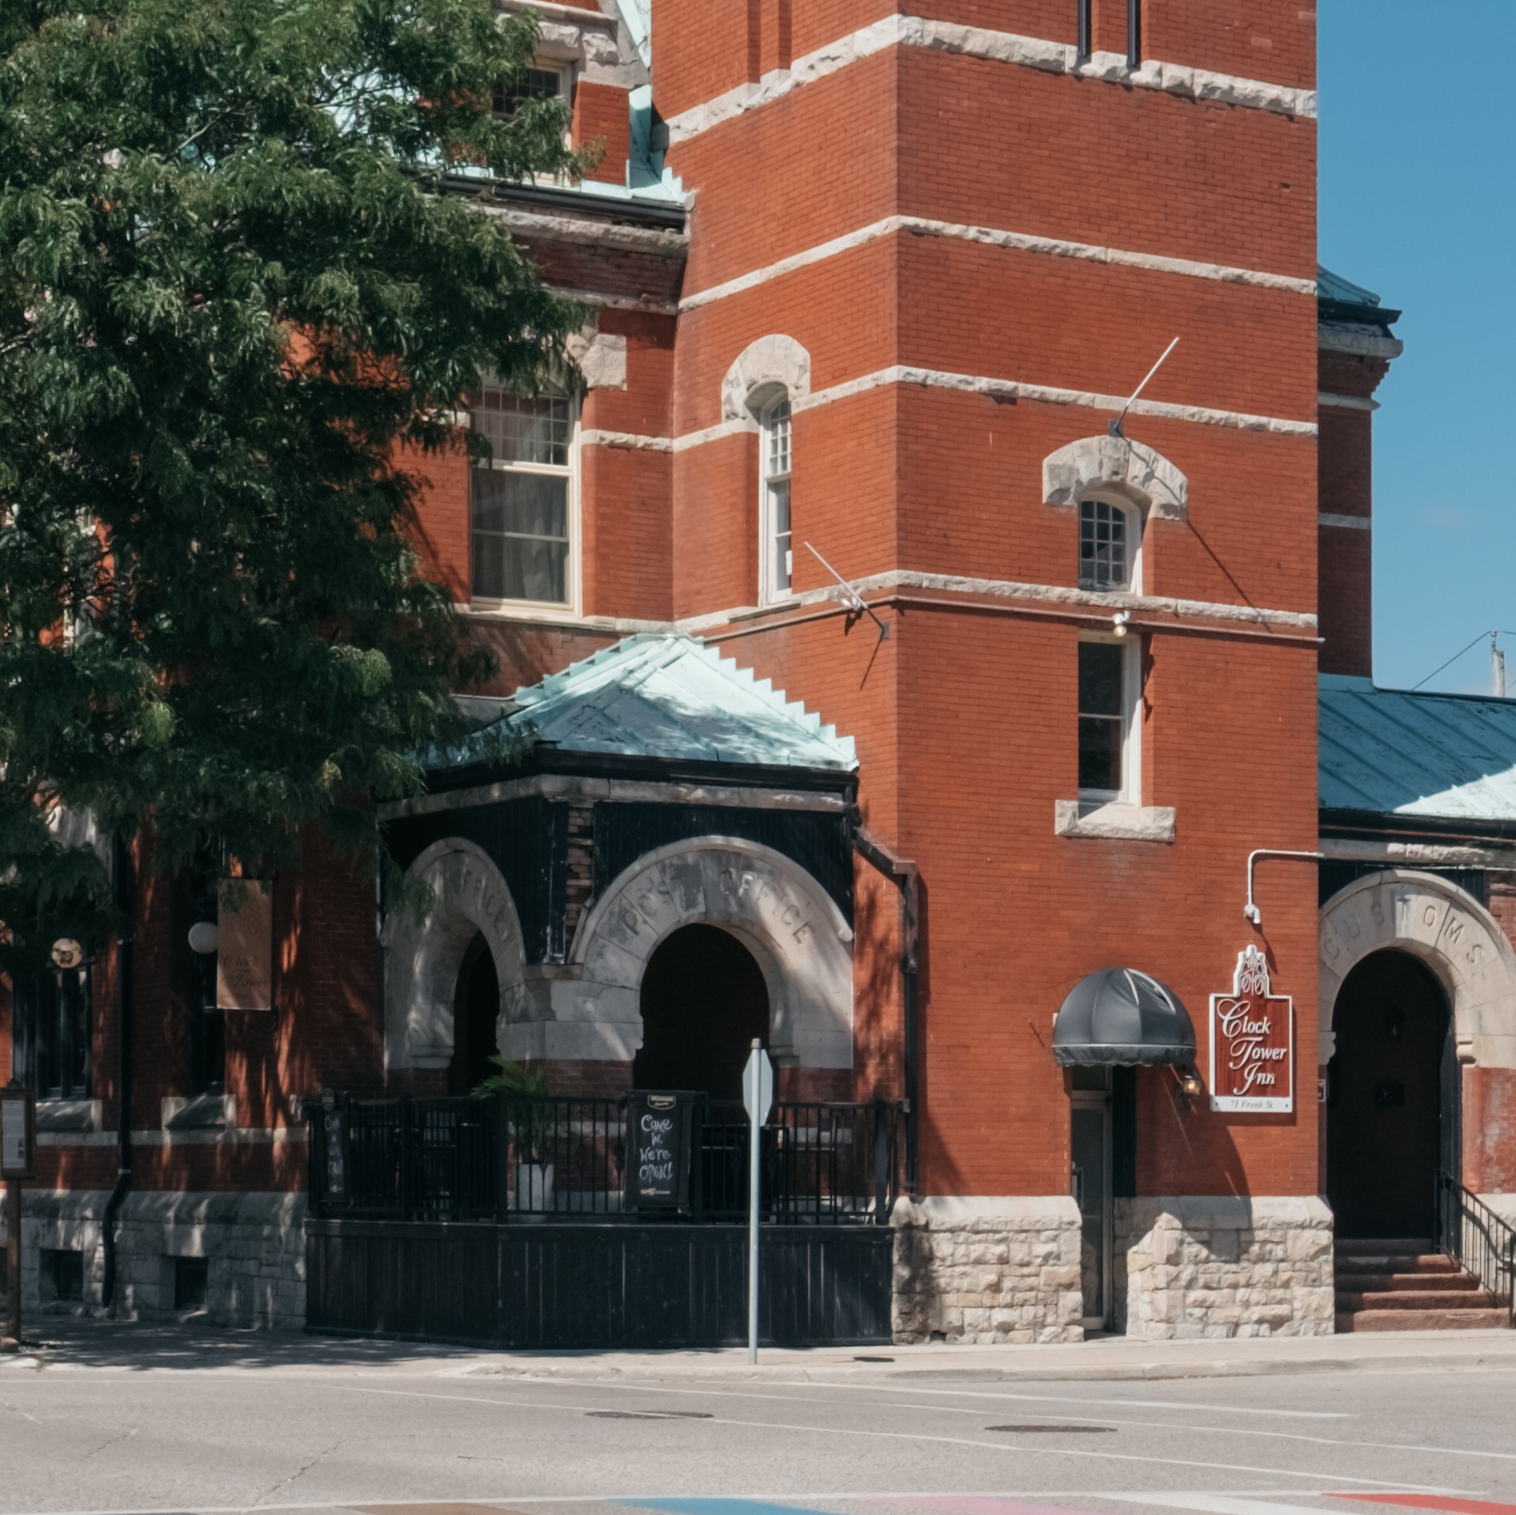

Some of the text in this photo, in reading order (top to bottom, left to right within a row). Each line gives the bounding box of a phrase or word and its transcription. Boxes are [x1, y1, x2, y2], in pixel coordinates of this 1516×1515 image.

[720, 867, 811, 944] OFFICE
[1323, 896, 1484, 964] CUSTOMS
[1217, 998, 1271, 1039] Clock
[1229, 1037, 1287, 1070] Tower
[1233, 1062, 1276, 1095] Inn
[1230, 1100, 1239, 1109] 71
[1241, 1100, 1263, 1109] Frank
[640, 1146, 672, 1163] We're
